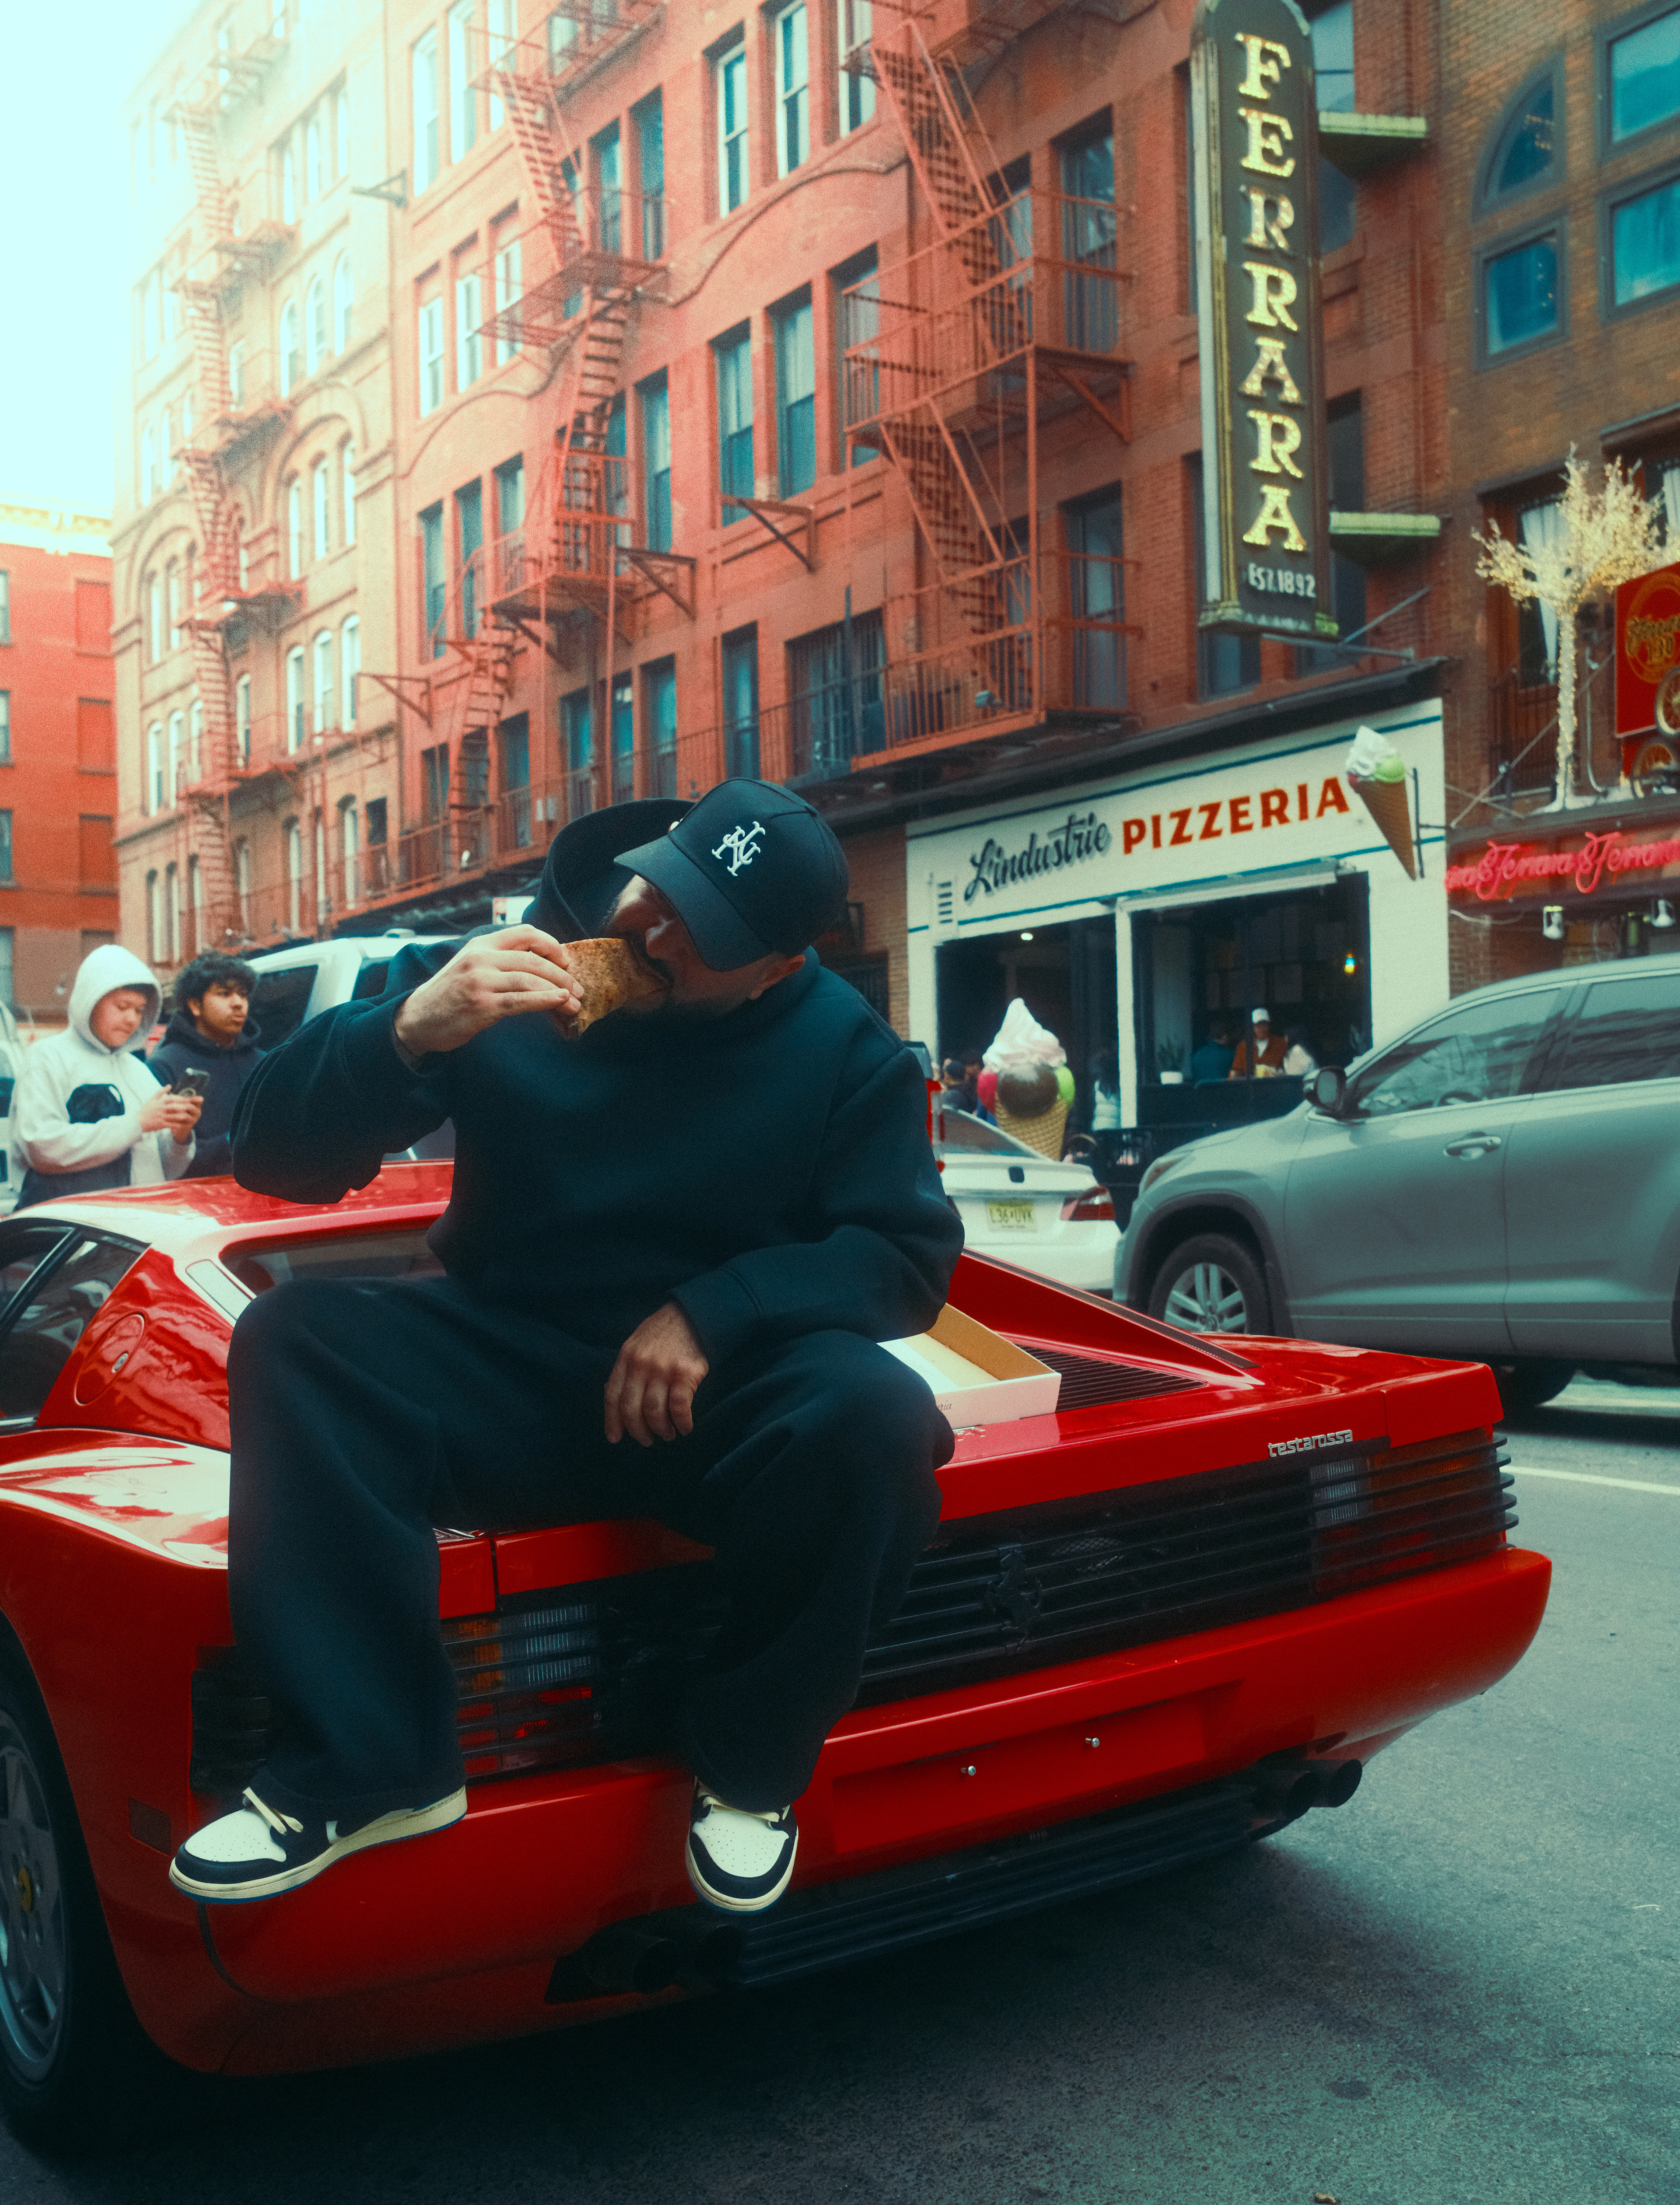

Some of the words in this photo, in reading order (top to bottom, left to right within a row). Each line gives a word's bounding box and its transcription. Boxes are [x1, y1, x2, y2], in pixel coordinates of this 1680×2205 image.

[1235, 32, 1307, 551] FERRARA
[1122, 776, 1351, 855] PIZZERIA
[1268, 1429, 1353, 1457] testarossa
